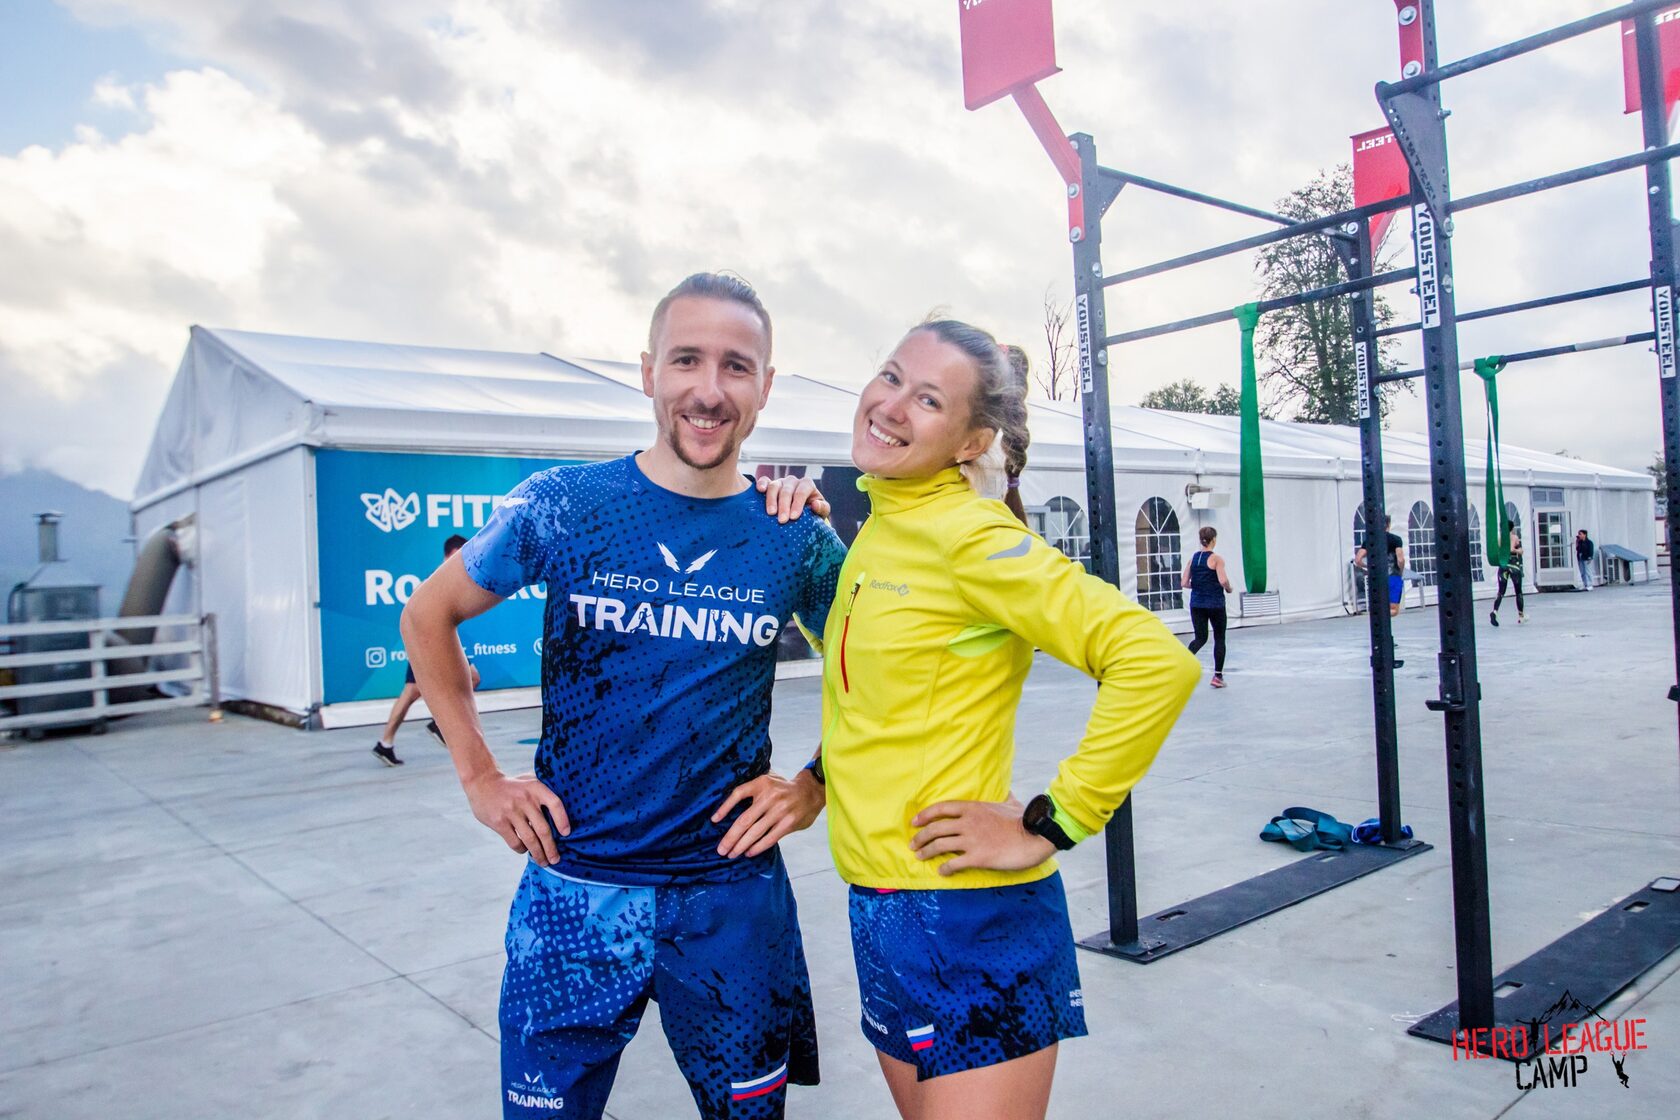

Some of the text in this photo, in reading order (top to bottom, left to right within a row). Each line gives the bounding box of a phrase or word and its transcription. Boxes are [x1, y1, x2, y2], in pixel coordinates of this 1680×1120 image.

[1418, 205, 1437, 324] YOUSTEEL
[1078, 298, 1091, 390] YOUSTEEL
[1658, 290, 1673, 375] YOUSTEEL
[1357, 345, 1368, 415] YOUSTEEL
[365, 569, 422, 606] Ro
[592, 571, 765, 604] HERO LEAGUE
[569, 593, 779, 647] TRAINING
[507, 1090, 564, 1109] TRAINING
